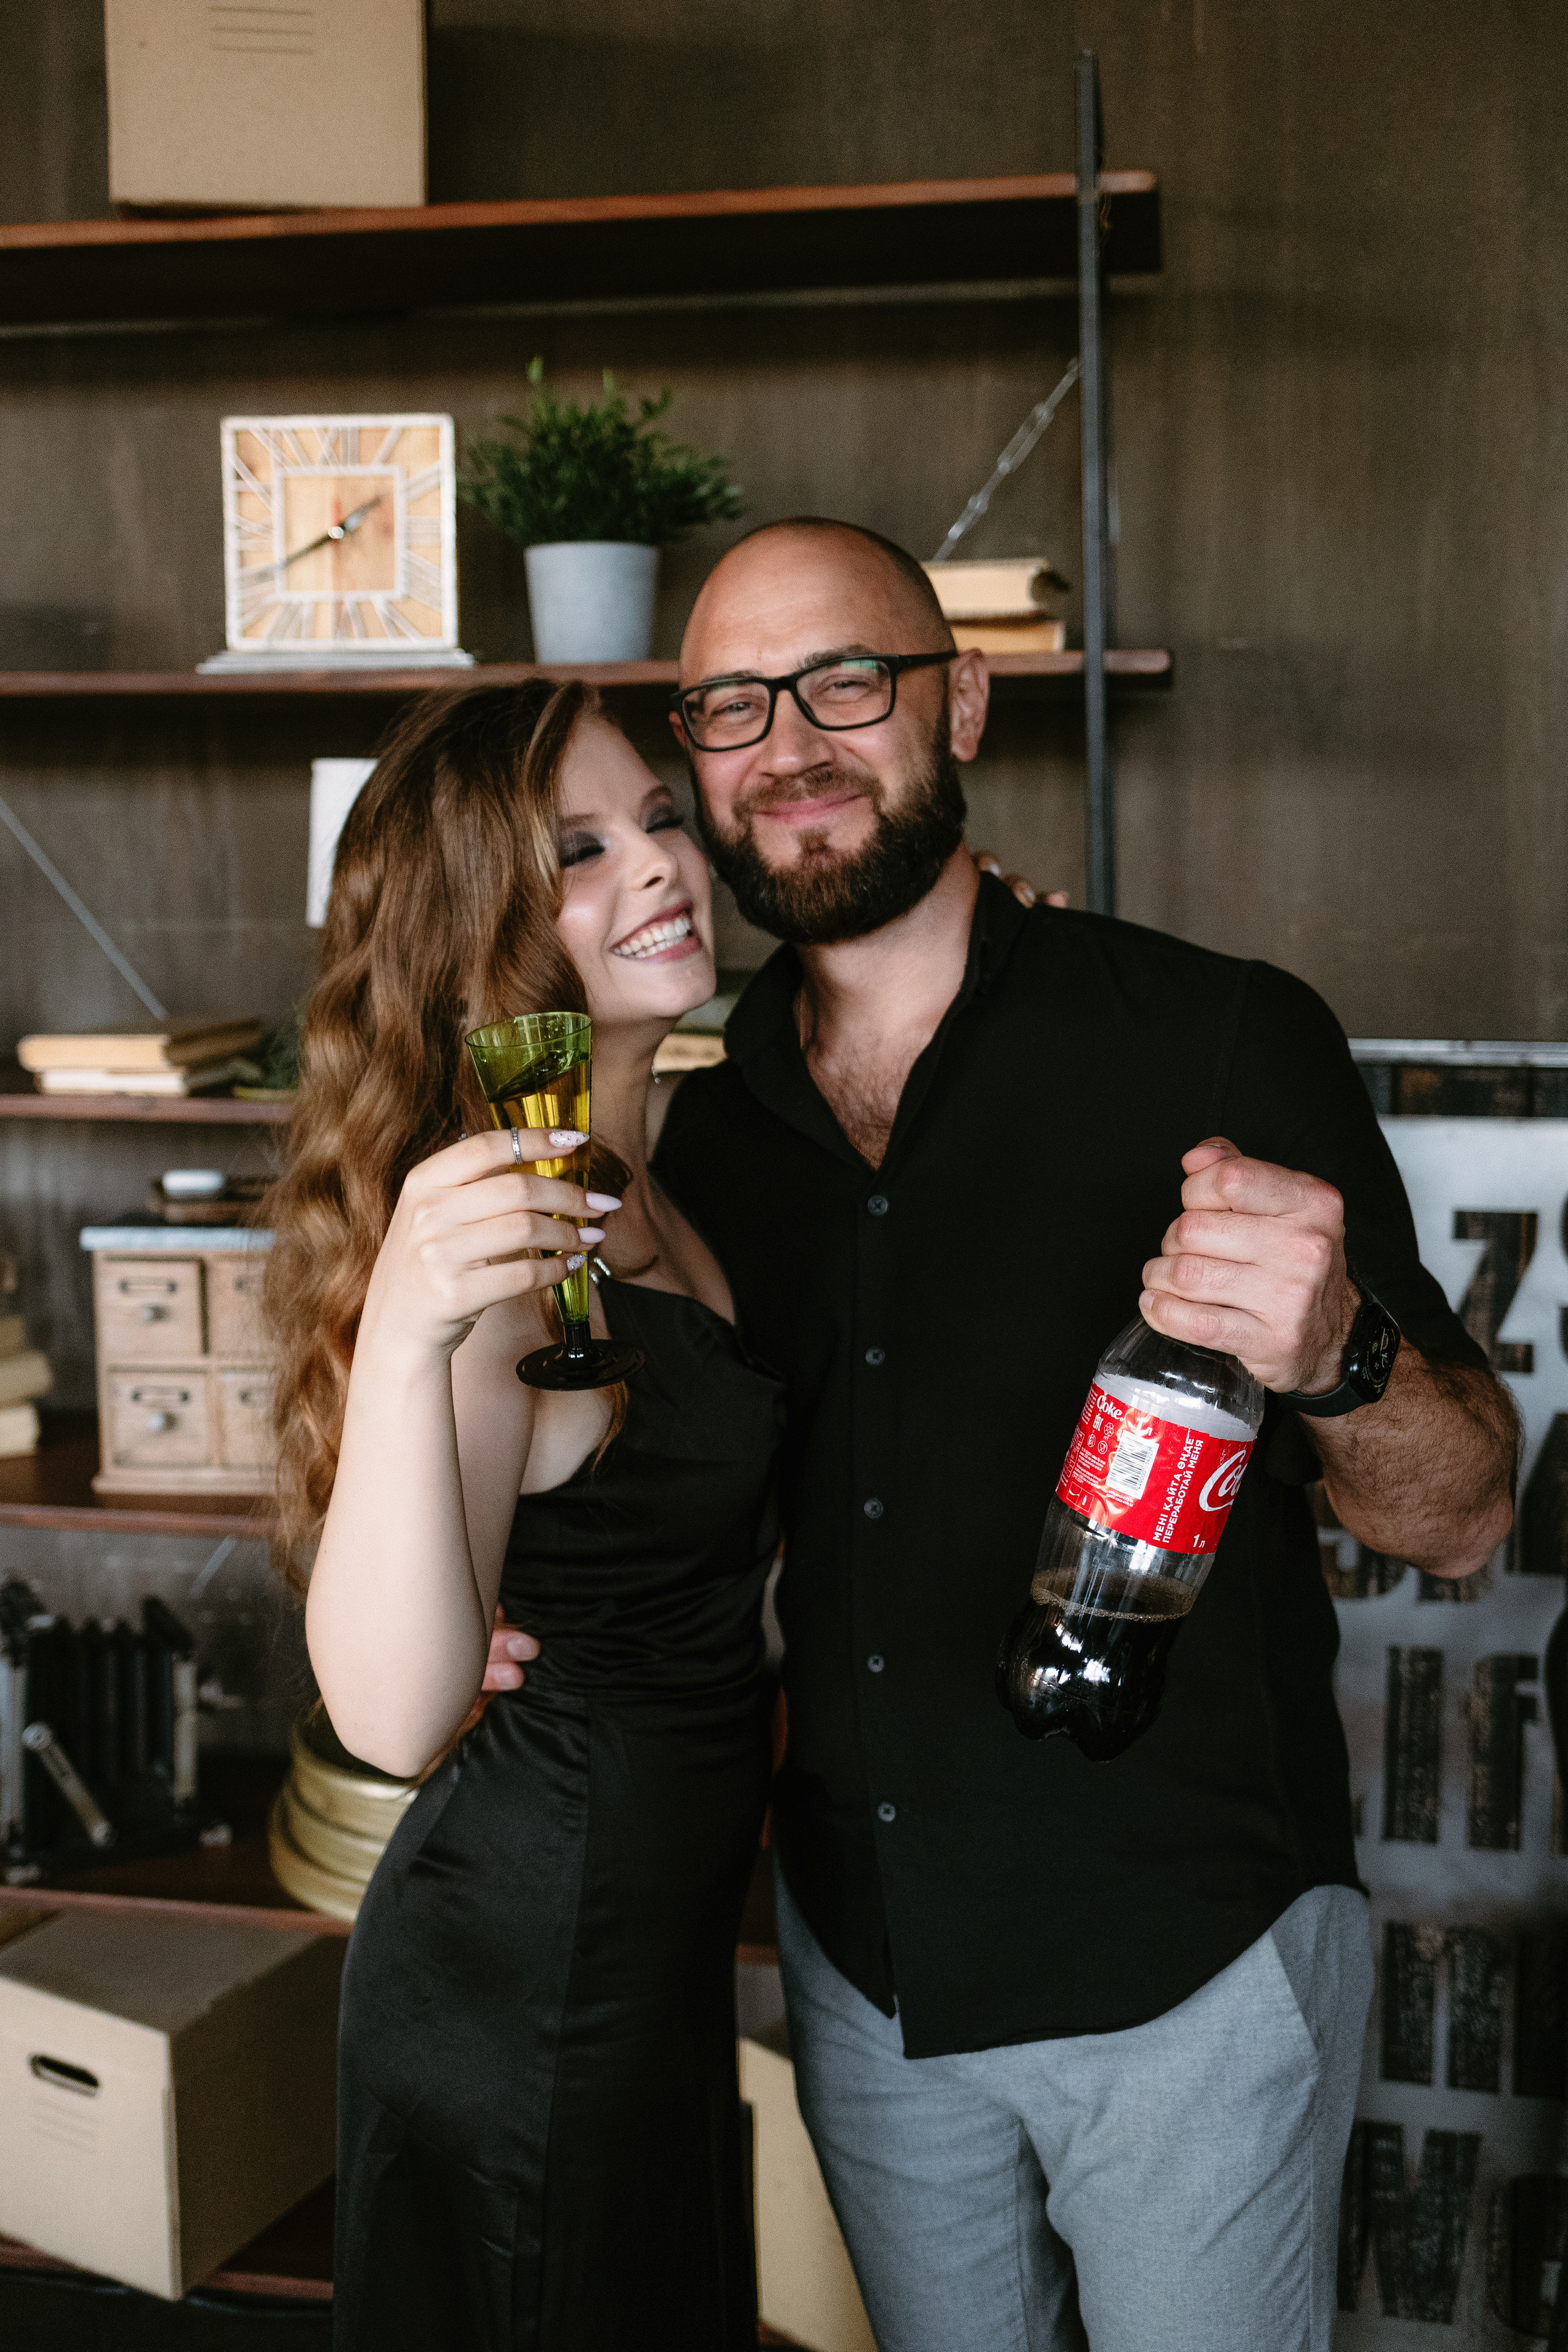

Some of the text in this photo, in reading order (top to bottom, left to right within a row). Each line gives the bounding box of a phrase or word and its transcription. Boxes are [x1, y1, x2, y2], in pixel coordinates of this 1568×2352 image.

[1153, 1438, 1194, 1541] МЕНІ ҚАЙТА ӨҢДЕ
[1162, 1439, 1204, 1543] ПЕРЕРАБОТАЙ МЕНЯ
